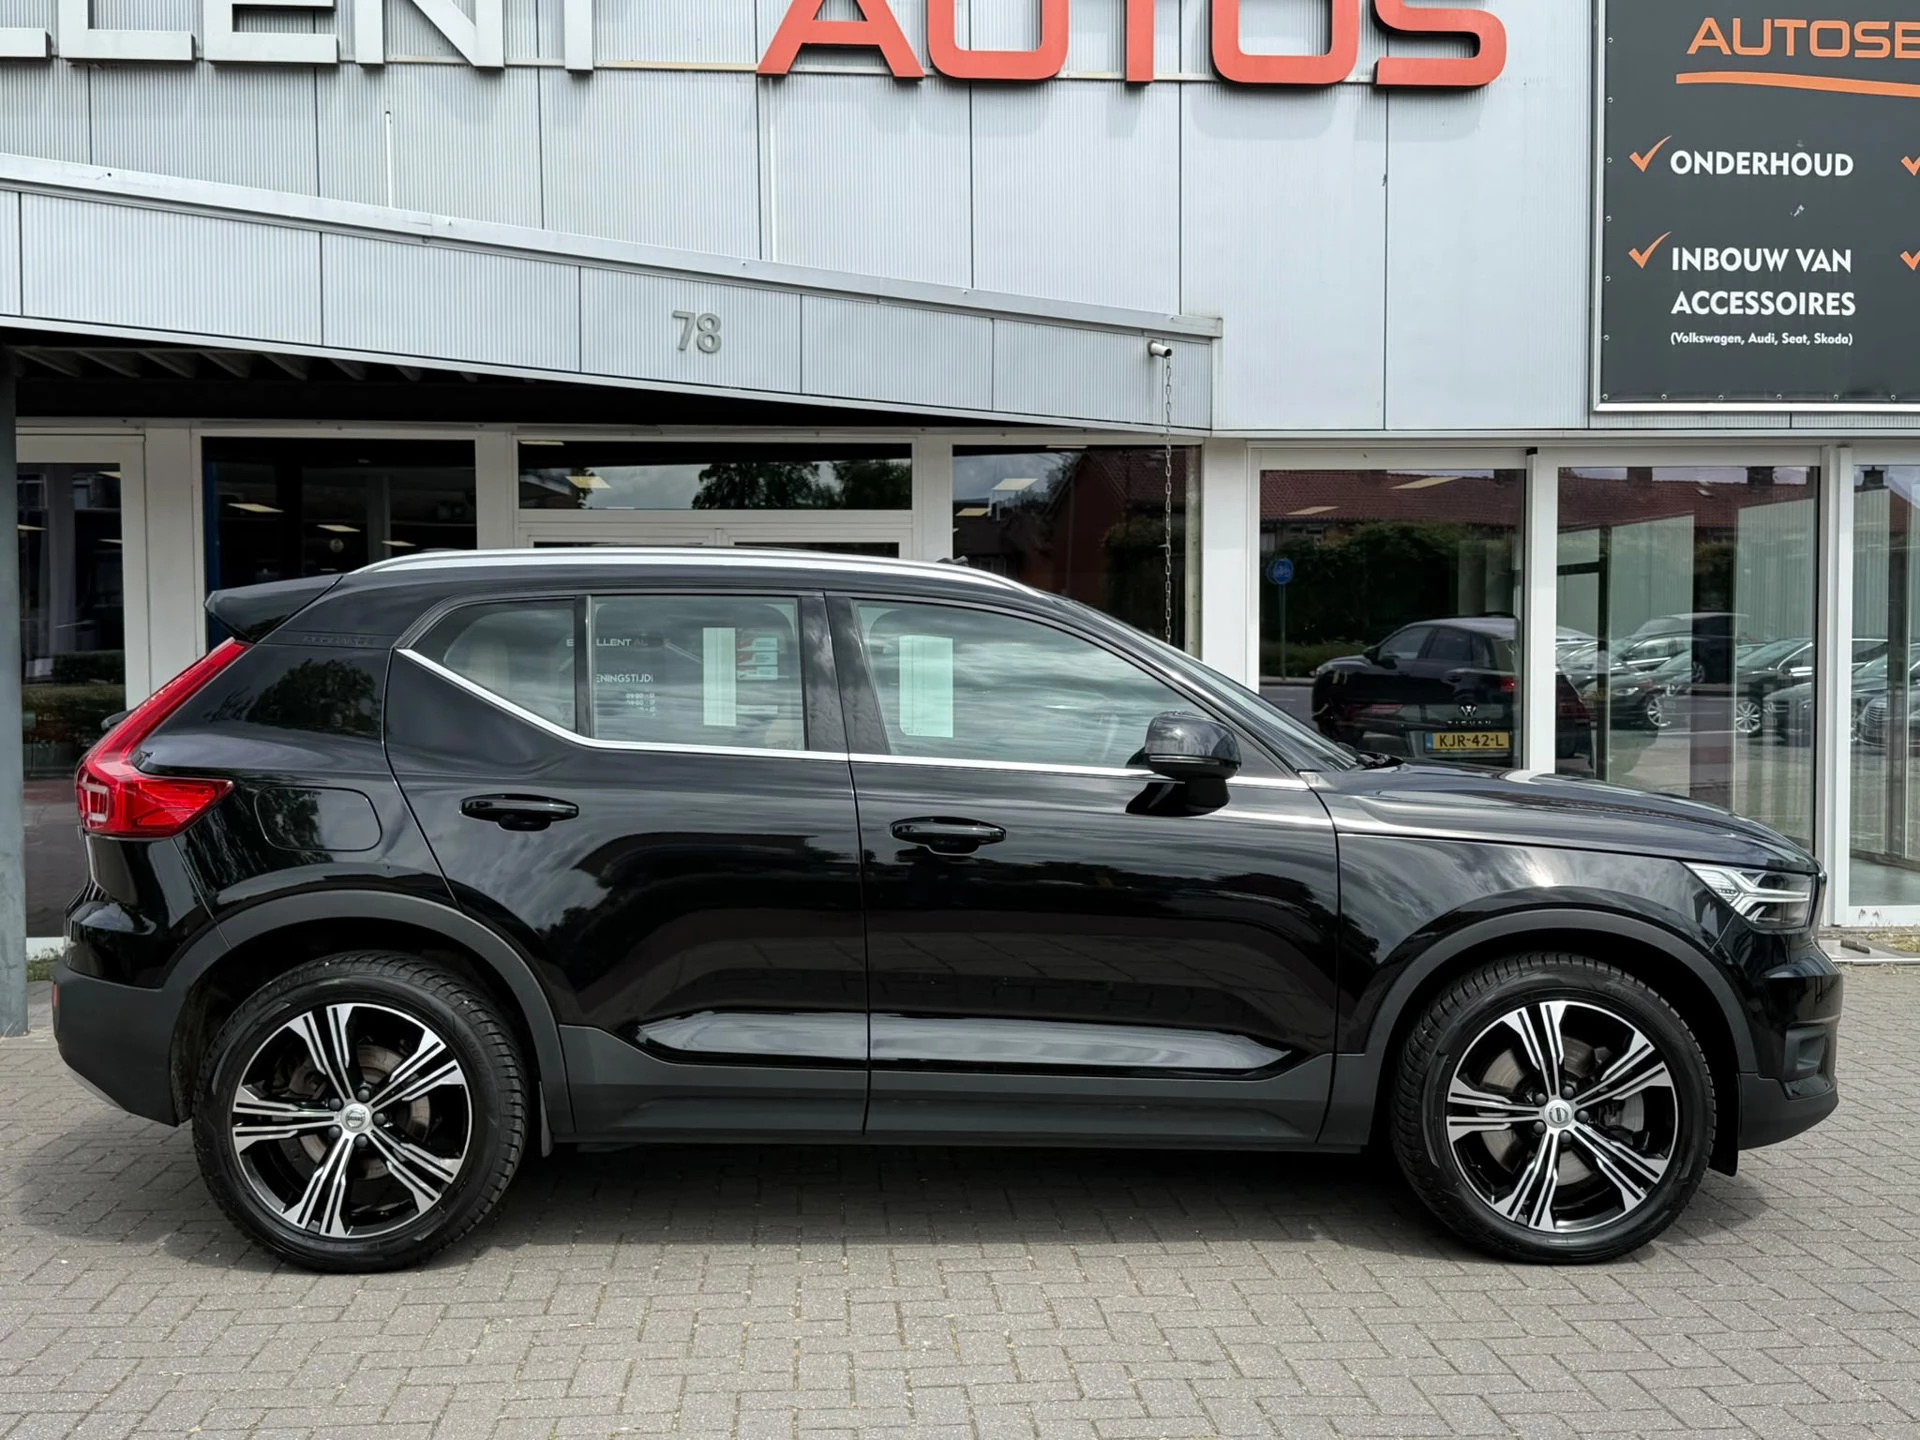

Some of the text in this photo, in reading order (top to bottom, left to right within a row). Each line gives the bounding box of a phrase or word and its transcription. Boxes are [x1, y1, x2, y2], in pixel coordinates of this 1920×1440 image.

[1686, 17, 1920, 59] AUTOSE
[1670, 150, 1854, 176] ONDERHOUD
[1672, 247, 1852, 273] INBOUW VAN
[1670, 290, 1856, 316] ACCESSOIRES
[672, 310, 722, 354] 78
[1670, 332, 1853, 346] (Volkswagen, Audi, Seat, Skoda)
[1439, 734, 1505, 747] KJR-42-L
